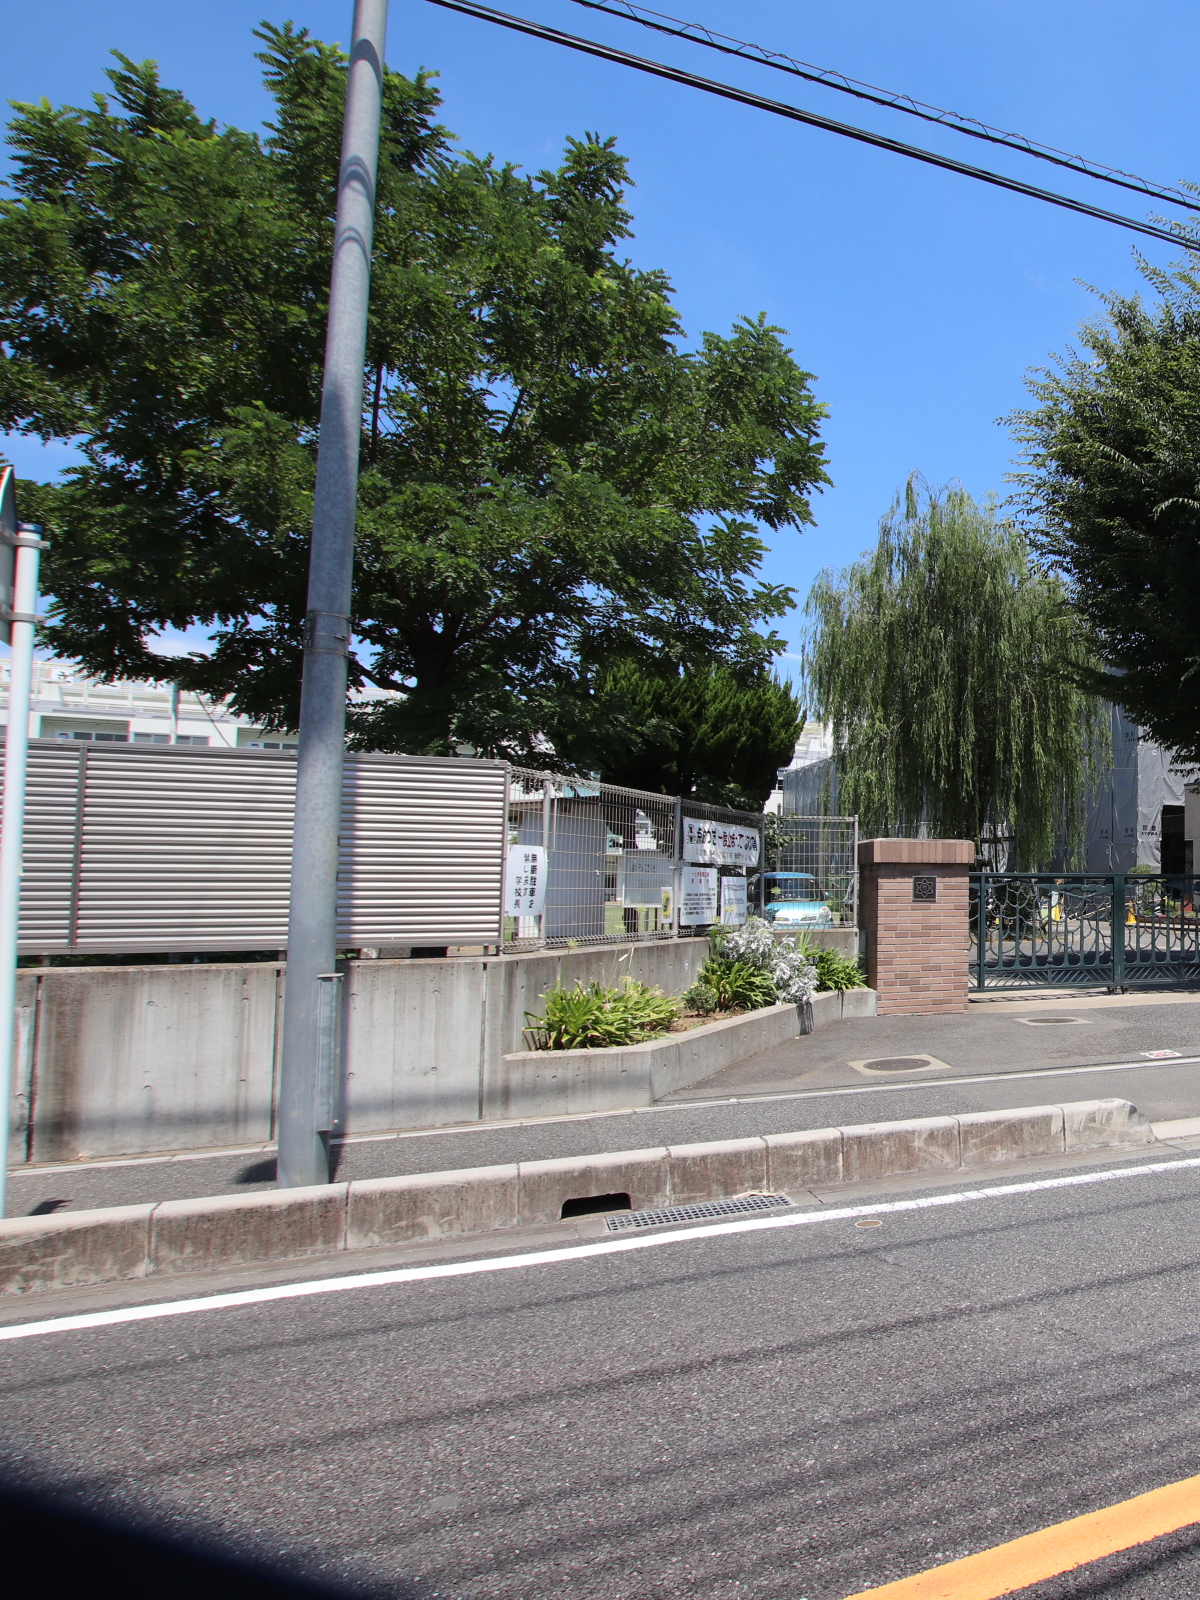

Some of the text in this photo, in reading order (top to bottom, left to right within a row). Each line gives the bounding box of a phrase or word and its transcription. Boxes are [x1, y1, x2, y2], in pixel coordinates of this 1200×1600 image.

[529, 853, 538, 909] 無断駐車を
